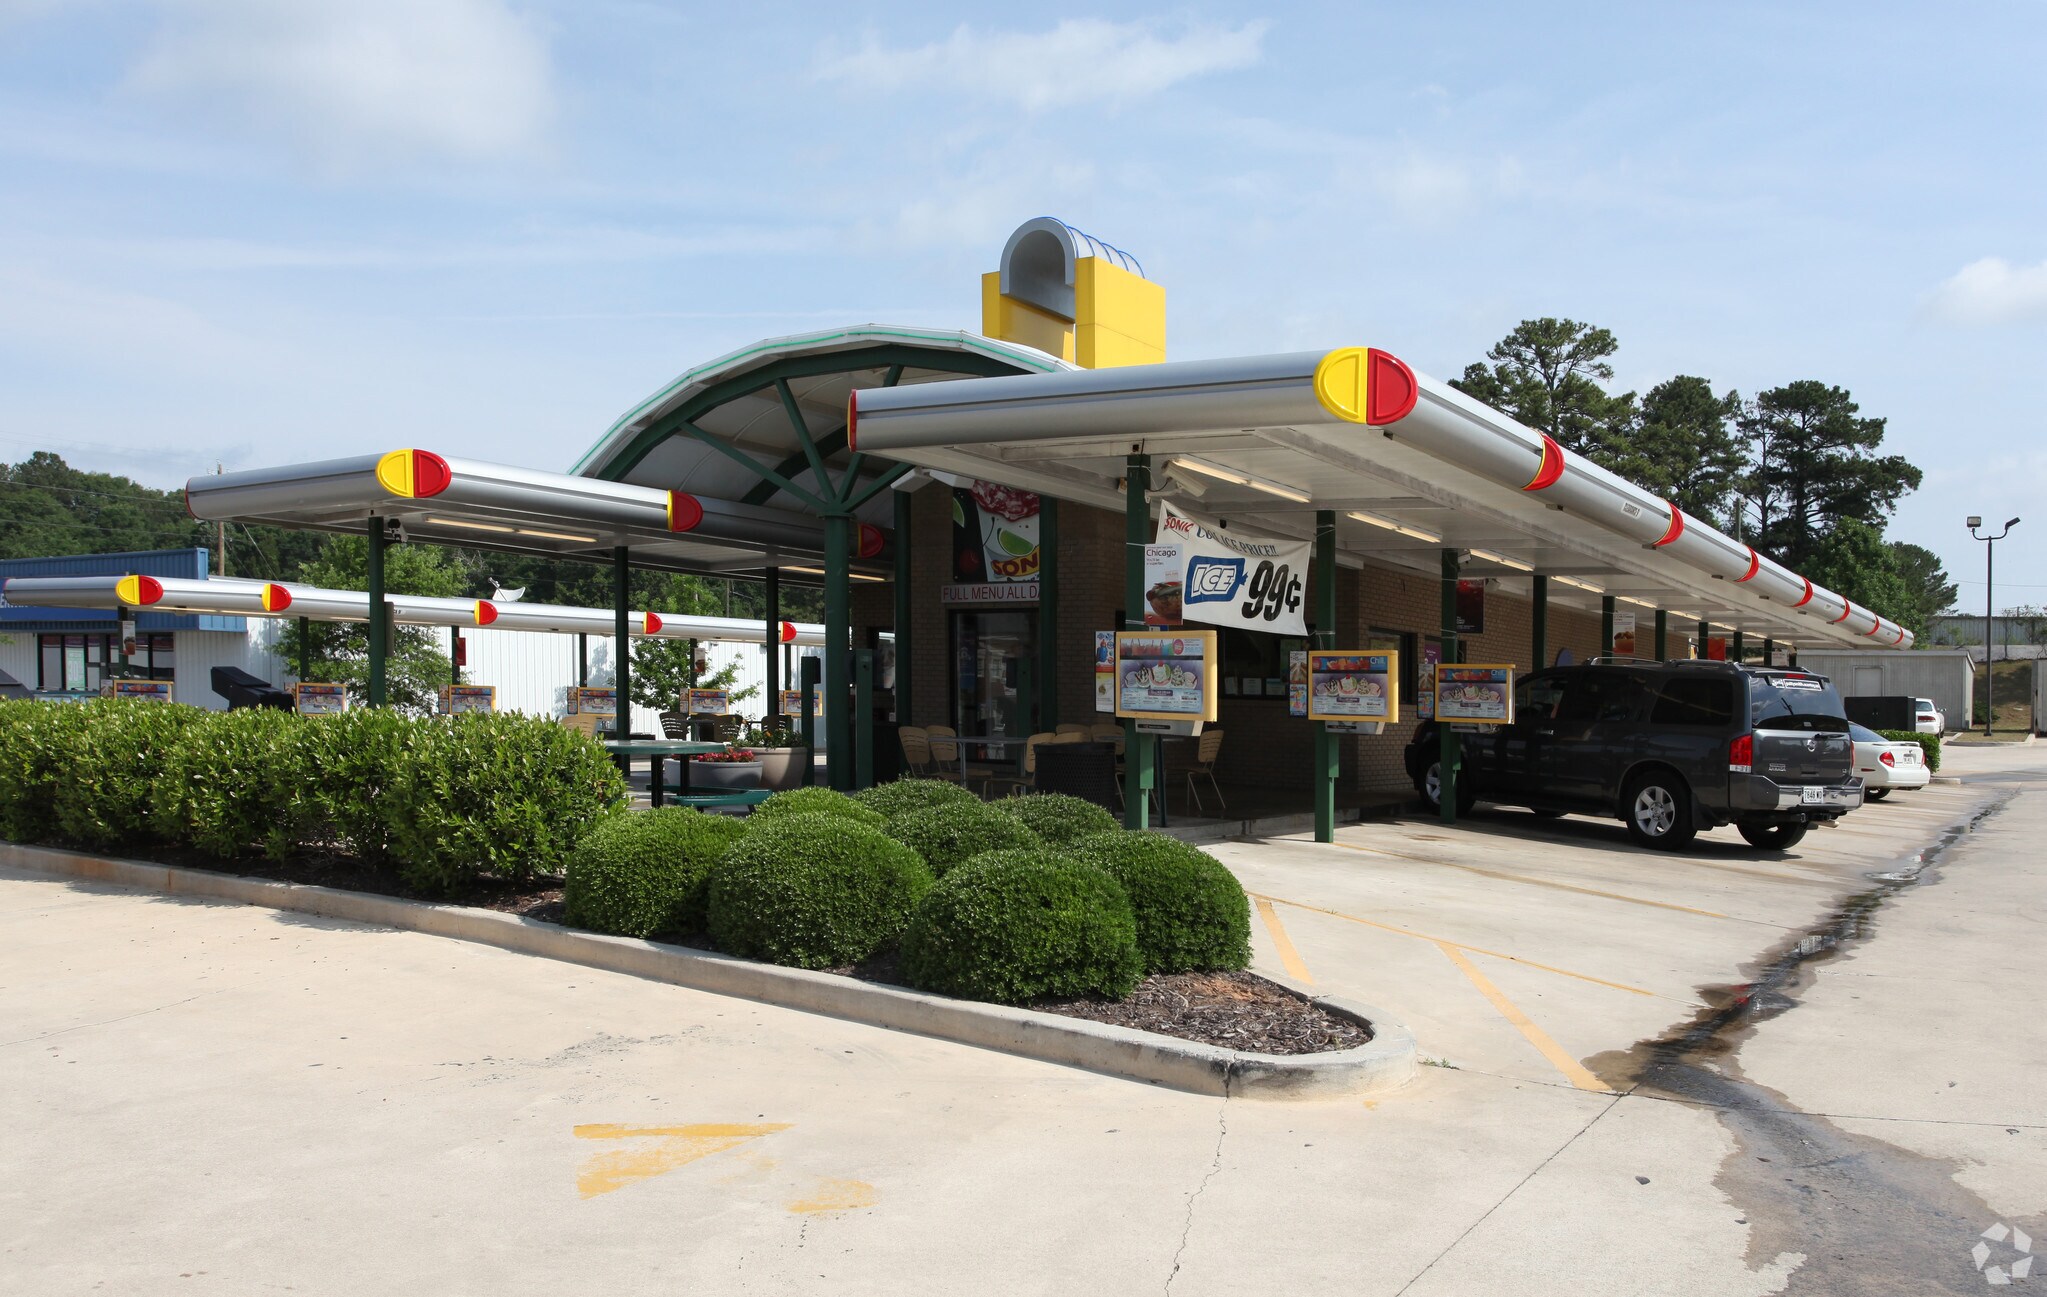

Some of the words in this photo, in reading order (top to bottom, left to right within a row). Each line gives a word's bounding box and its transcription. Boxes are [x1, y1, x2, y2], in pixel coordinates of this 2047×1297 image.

[1164, 515, 1194, 533] SONIC
[1146, 549, 1177, 558] Chicago
[1191, 564, 1236, 598] ICE
[943, 587, 969, 600] FULL
[971, 586, 1005, 600] MENU
[1006, 585, 1027, 599] ALL
